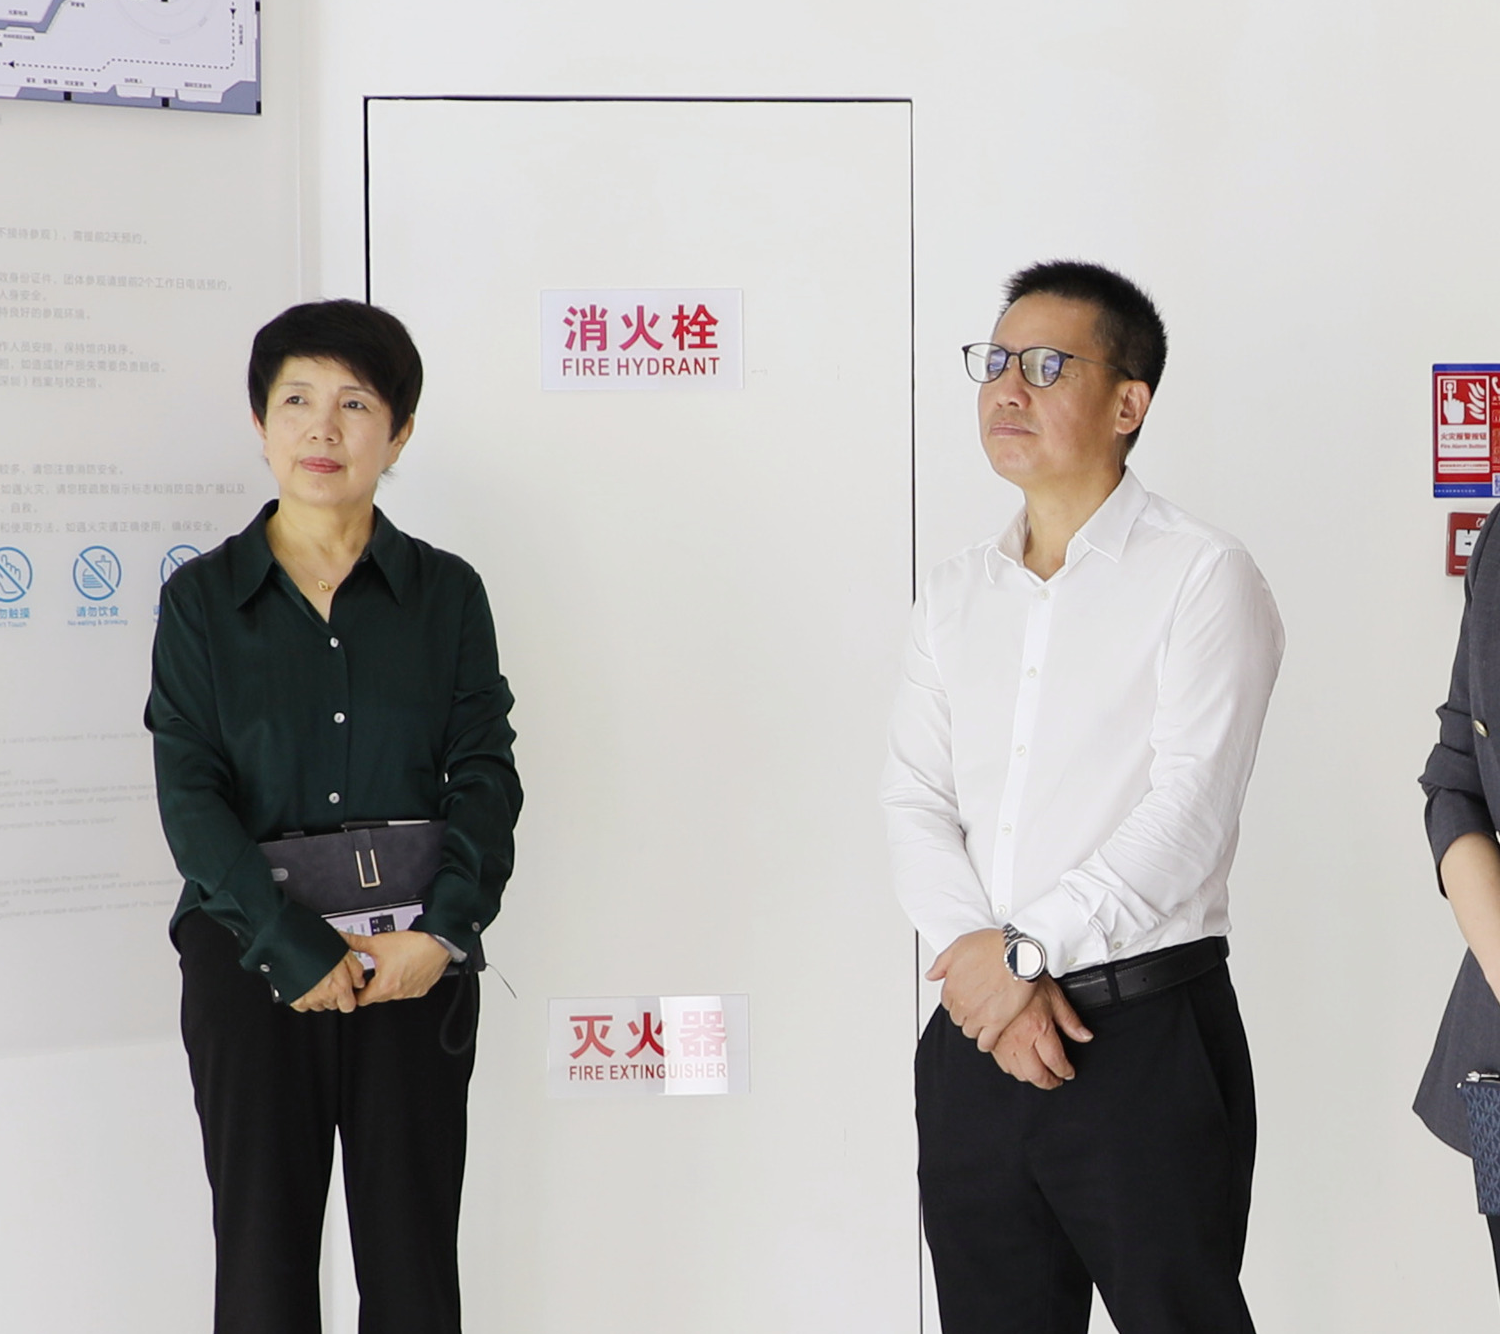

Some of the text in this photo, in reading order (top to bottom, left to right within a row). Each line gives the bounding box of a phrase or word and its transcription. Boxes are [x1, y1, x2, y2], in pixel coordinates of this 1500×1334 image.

[563, 304, 719, 352] 消火栓
[562, 357, 720, 376] FIRE HYDRANT
[568, 1011, 727, 1059] 灭火器
[568, 1063, 727, 1081] FIRE EXTINGUISHER
